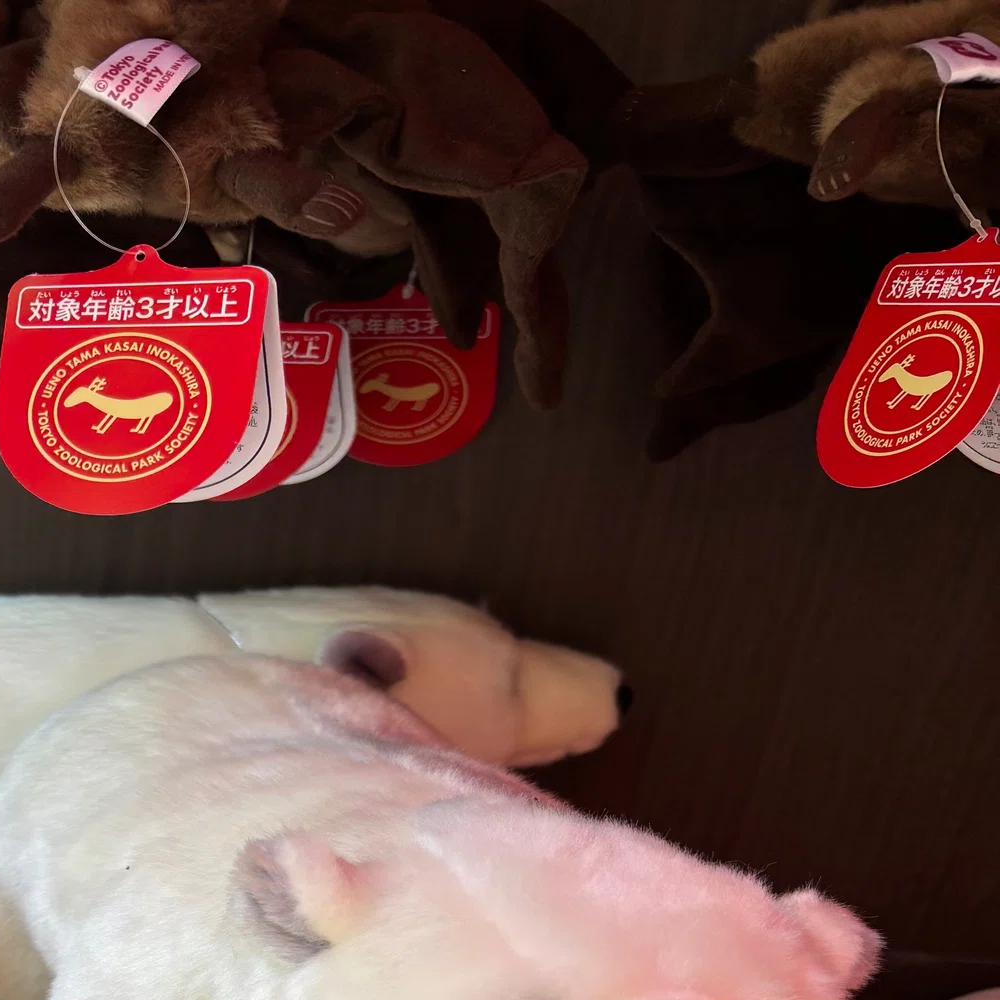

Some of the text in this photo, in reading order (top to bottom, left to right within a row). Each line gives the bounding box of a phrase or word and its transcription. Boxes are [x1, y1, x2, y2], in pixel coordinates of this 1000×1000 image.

[107, 51, 160, 101] Zoological
[122, 66, 163, 109] Society
[153, 70, 175, 92] MADE
[28, 294, 238, 321] 対象年齢3才以上
[42, 341, 200, 399] UENO TAMA KASAI INOKASHIRA
[868, 320, 977, 378] UENO TAMA KASAI INOKASHIRA
[37, 410, 57, 447] TOKYO
[53, 445, 128, 474] ZOOLOGICAL
[131, 451, 165, 472] PARK
[164, 412, 199, 455] SOCIETY
[852, 384, 964, 448] TOKYO ZOOLOGICAL PARK SOCIETY
